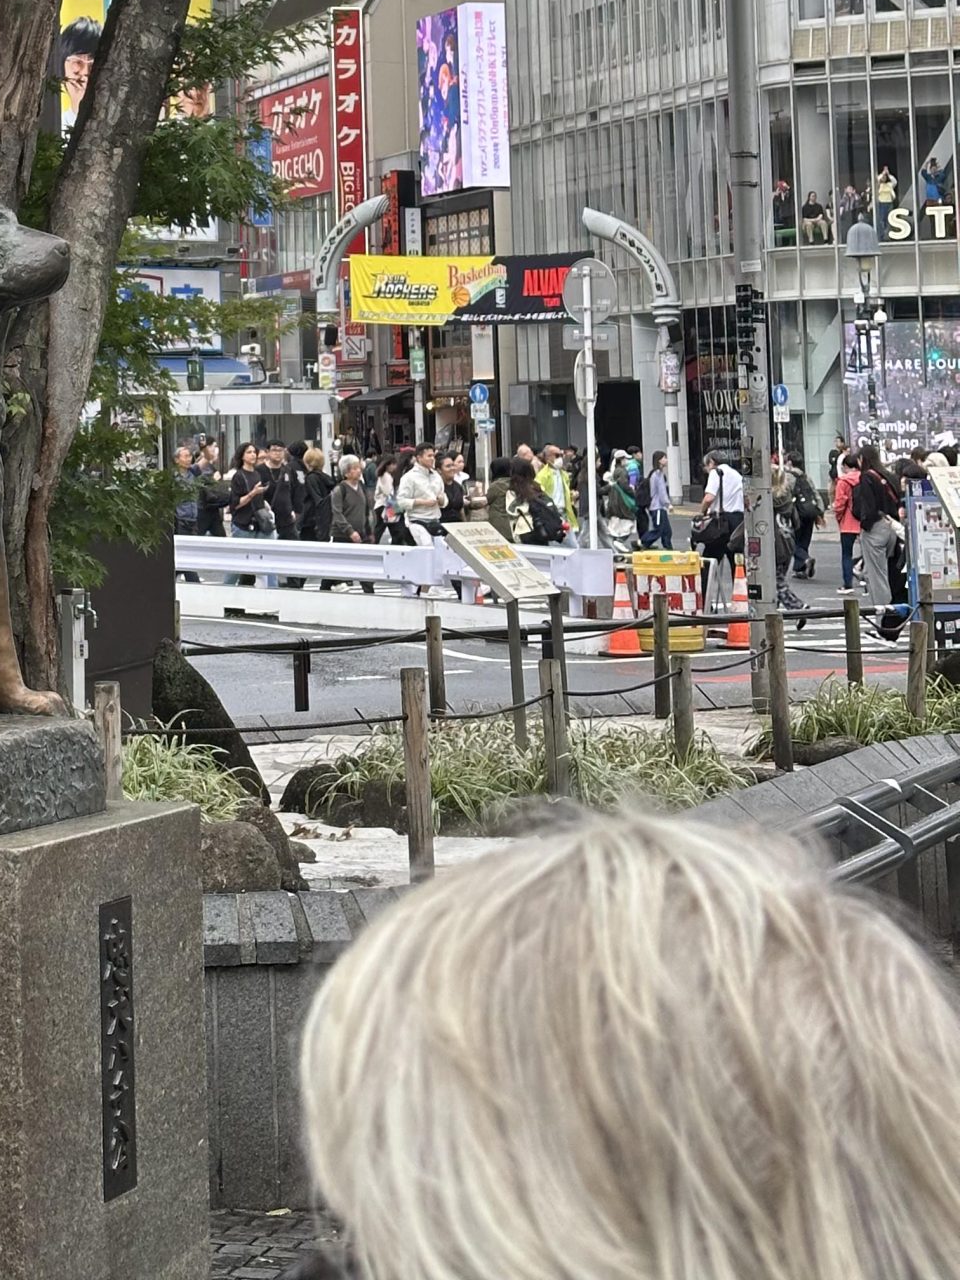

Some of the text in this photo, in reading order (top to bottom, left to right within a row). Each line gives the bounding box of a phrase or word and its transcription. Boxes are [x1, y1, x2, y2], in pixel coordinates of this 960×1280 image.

[336, 25, 361, 147] カラオケ
[271, 88, 322, 137] カラオケ
[293, 148, 324, 182] ECHO
[340, 161, 355, 192] BIG
[373, 274, 438, 300] ROCKERS
[874, 359, 921, 370] SHARE
[857, 420, 918, 433] Scamble
